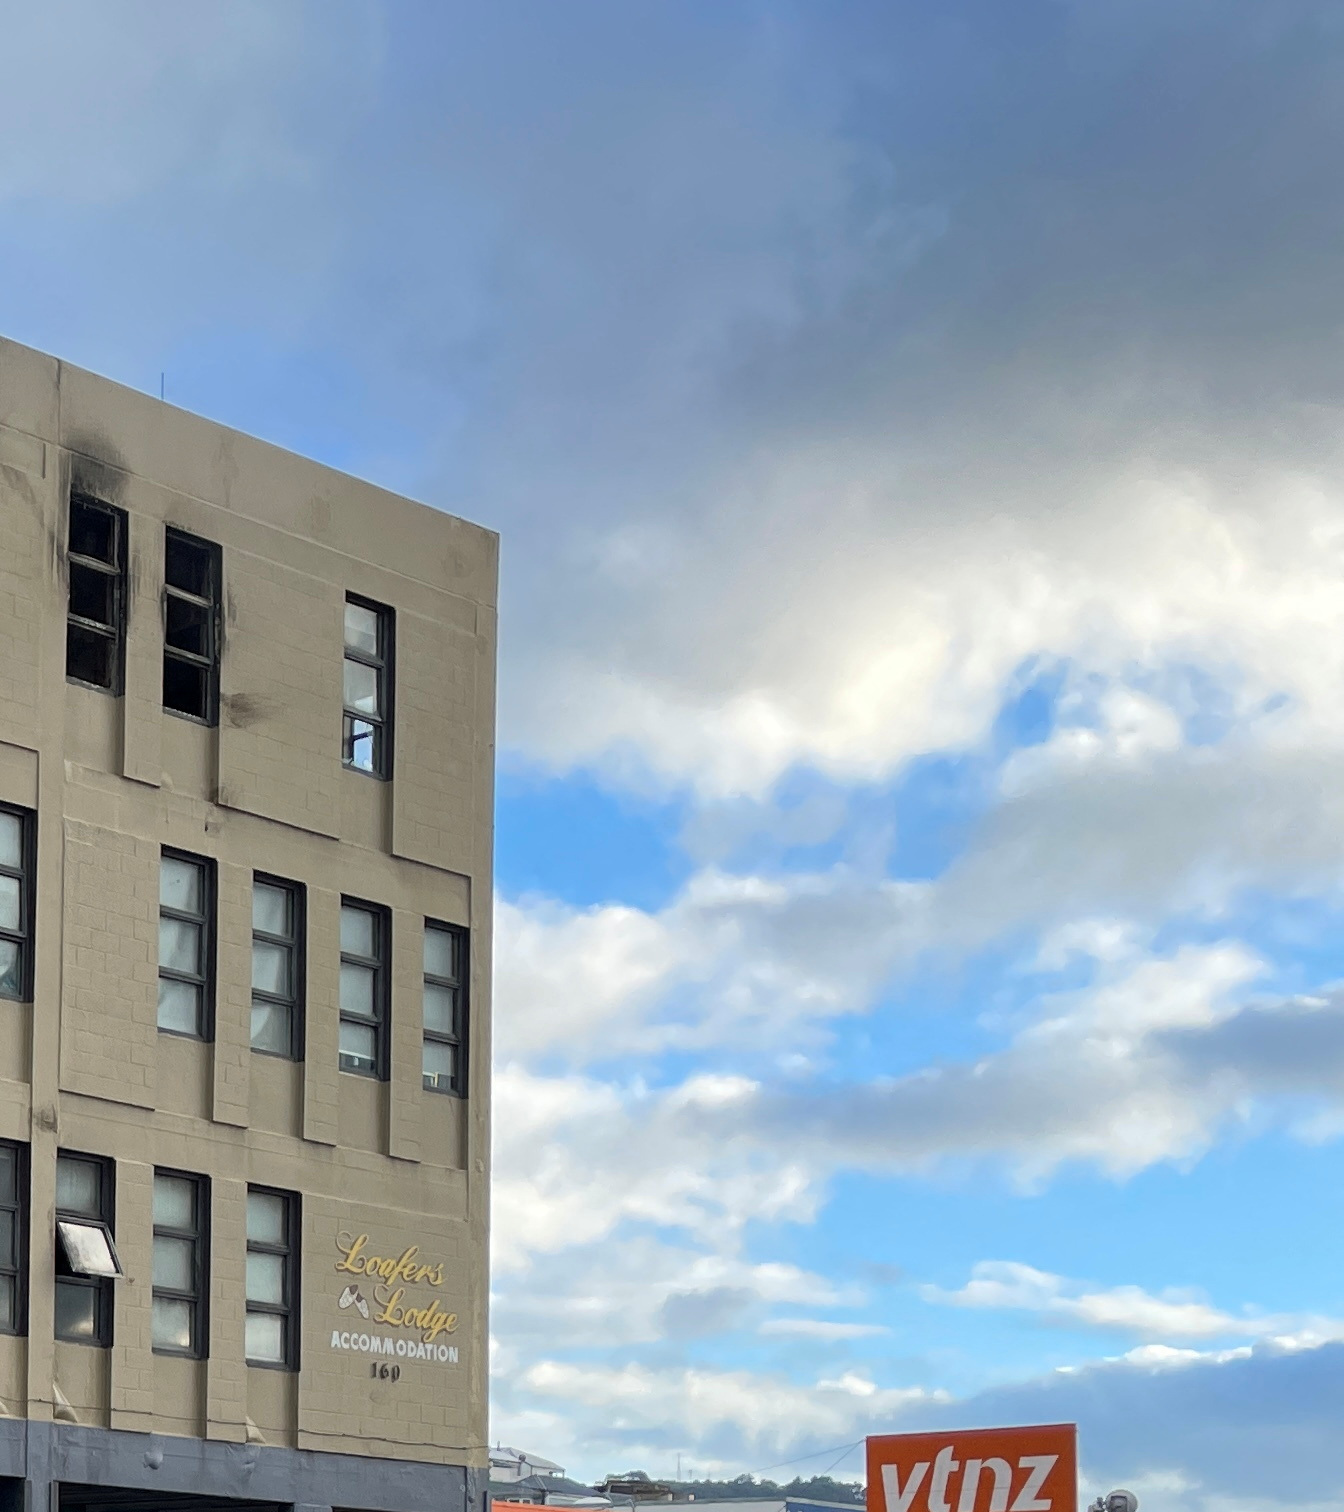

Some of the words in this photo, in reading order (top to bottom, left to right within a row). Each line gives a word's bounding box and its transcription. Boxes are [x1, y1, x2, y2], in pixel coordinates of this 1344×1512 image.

[335, 1230, 447, 1286] Loafers
[372, 1283, 461, 1344] Lodge
[330, 1330, 459, 1363] ACCOMMODATION
[370, 1361, 401, 1383] 160
